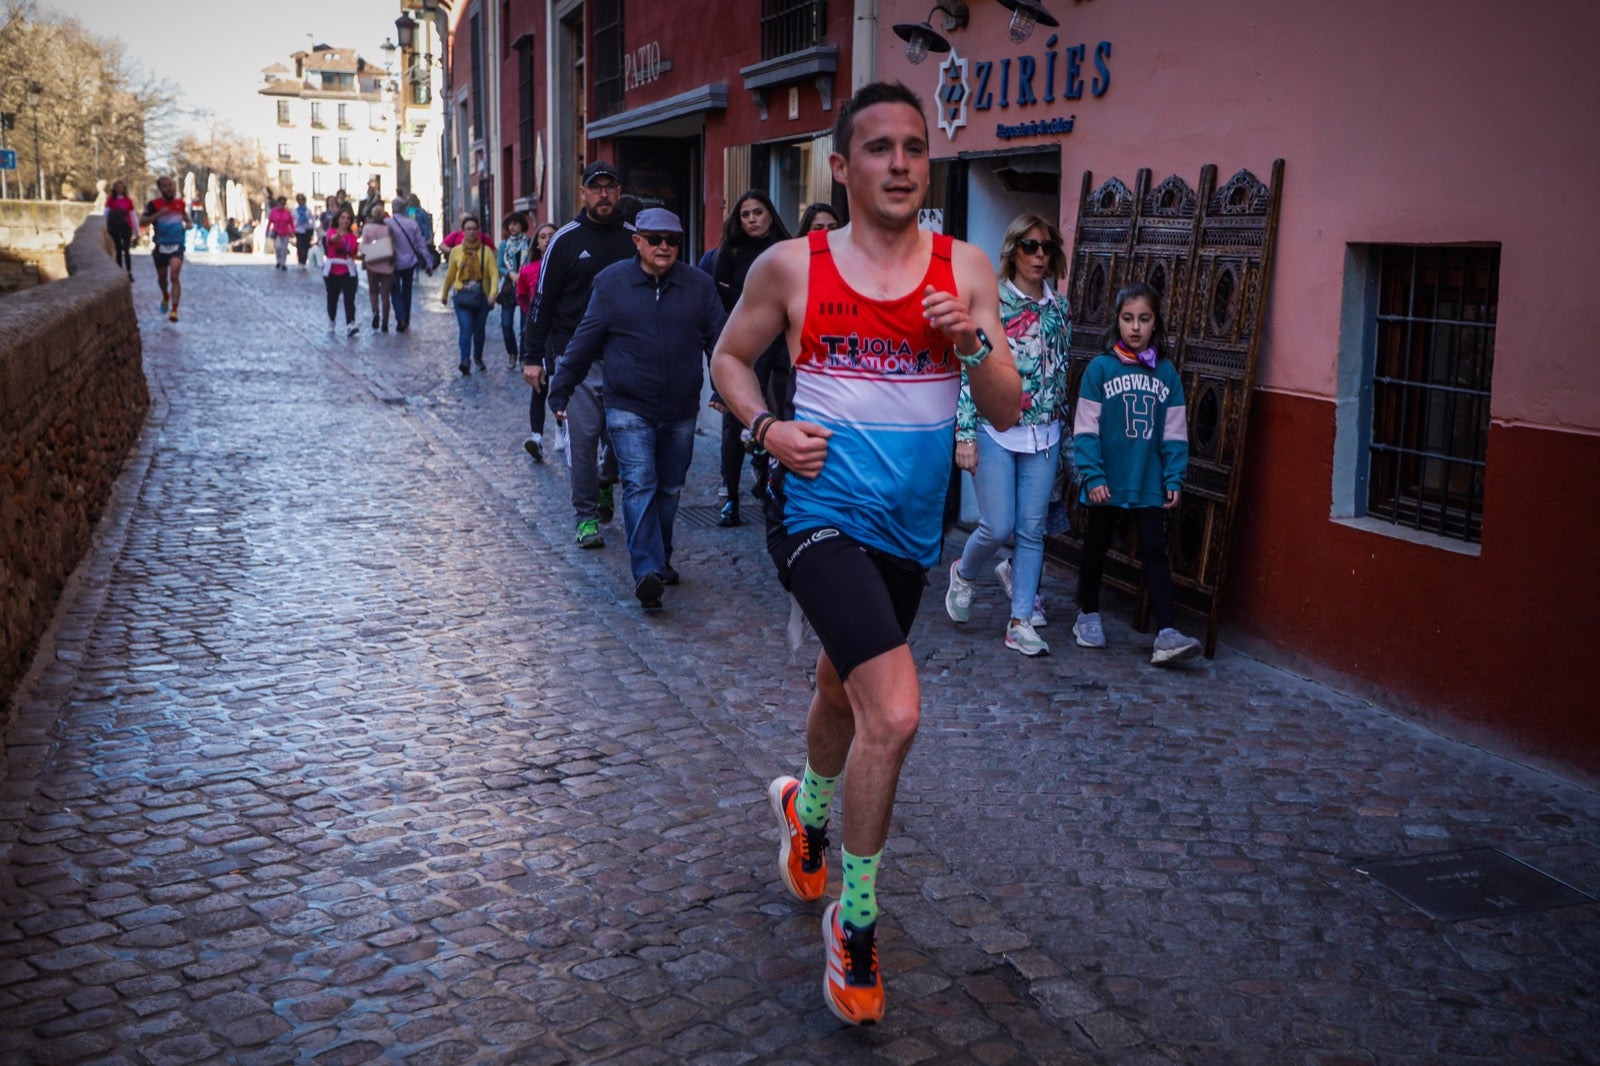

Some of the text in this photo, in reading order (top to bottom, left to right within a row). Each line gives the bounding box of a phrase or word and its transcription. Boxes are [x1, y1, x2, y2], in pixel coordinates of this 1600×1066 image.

[624, 41, 661, 91] PATIO
[974, 34, 1112, 110] ZIRÍES
[829, 353, 913, 372] TRATLÓN
[1123, 394, 1155, 439] H
